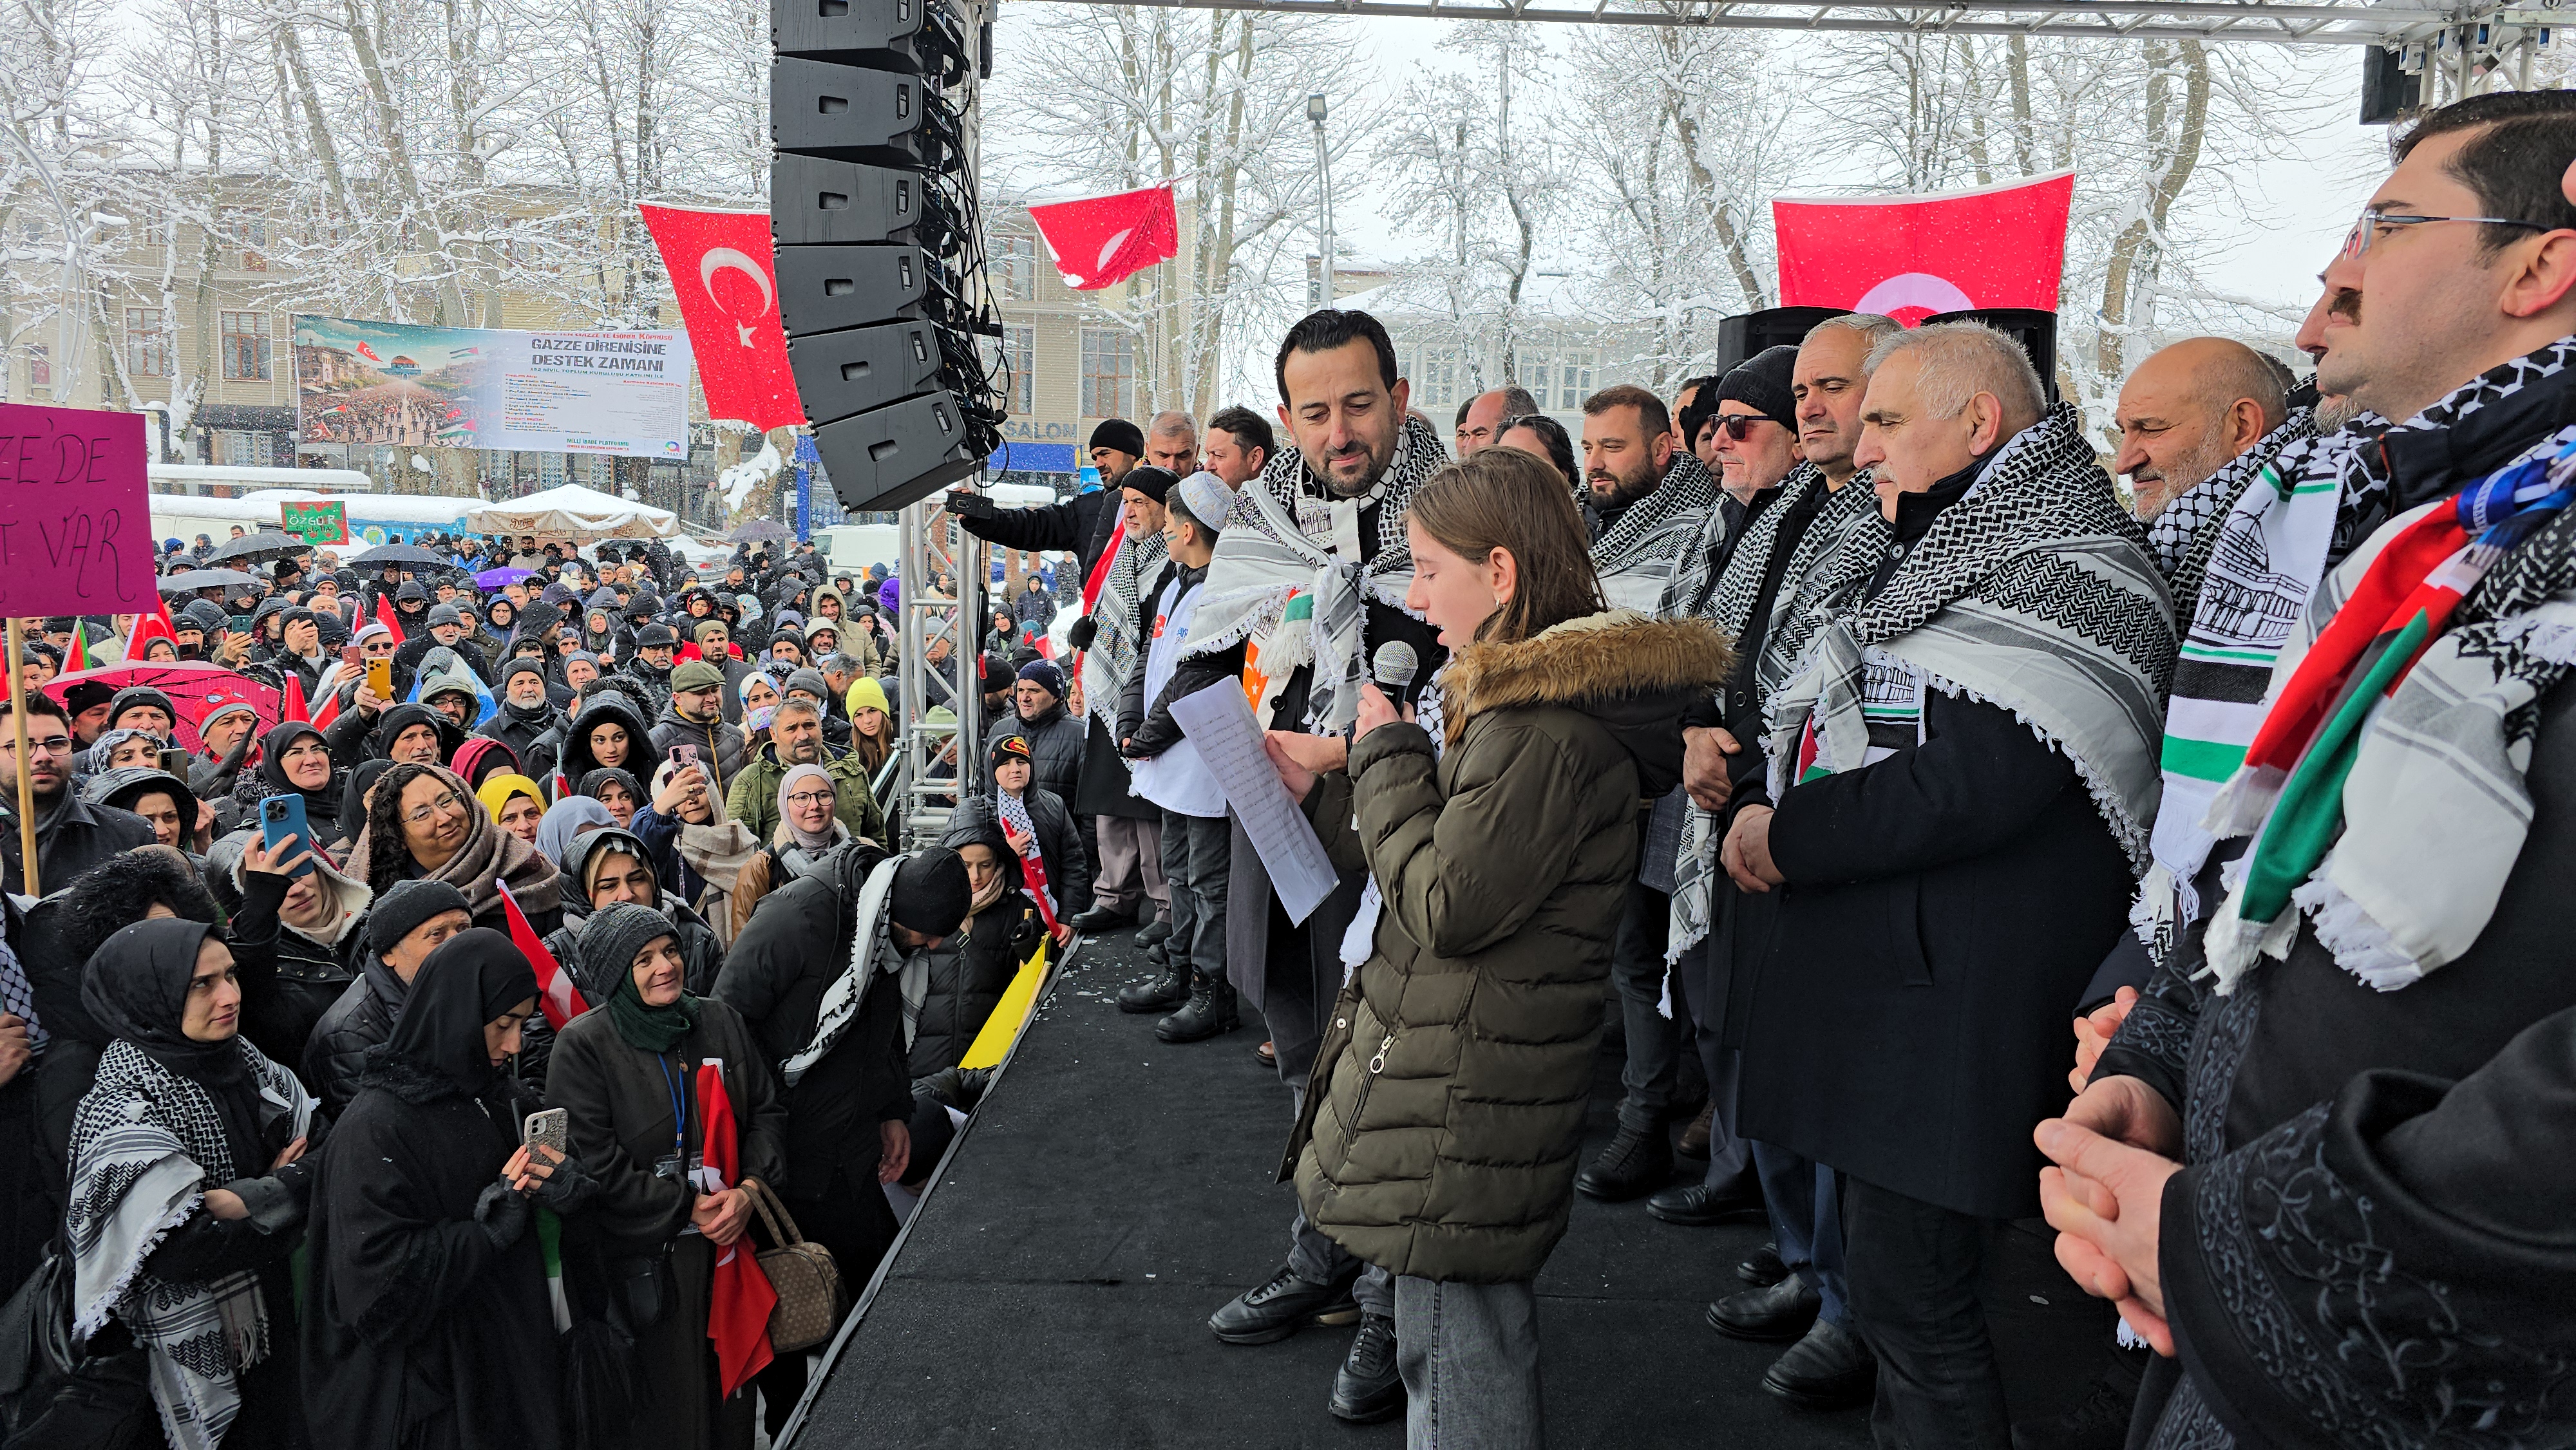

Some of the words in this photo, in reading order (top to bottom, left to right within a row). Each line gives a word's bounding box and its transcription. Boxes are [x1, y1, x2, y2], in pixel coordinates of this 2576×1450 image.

[531, 339, 582, 351] GAZZE
[584, 339, 667, 356] DİRENİŞİNE
[531, 354, 594, 368] DESTEK
[597, 356, 664, 372] ZAMANI
[1003, 420, 1077, 439] SALON
[289, 514, 336, 525] ÖZGÜR
[39, 506, 137, 602] VAR
